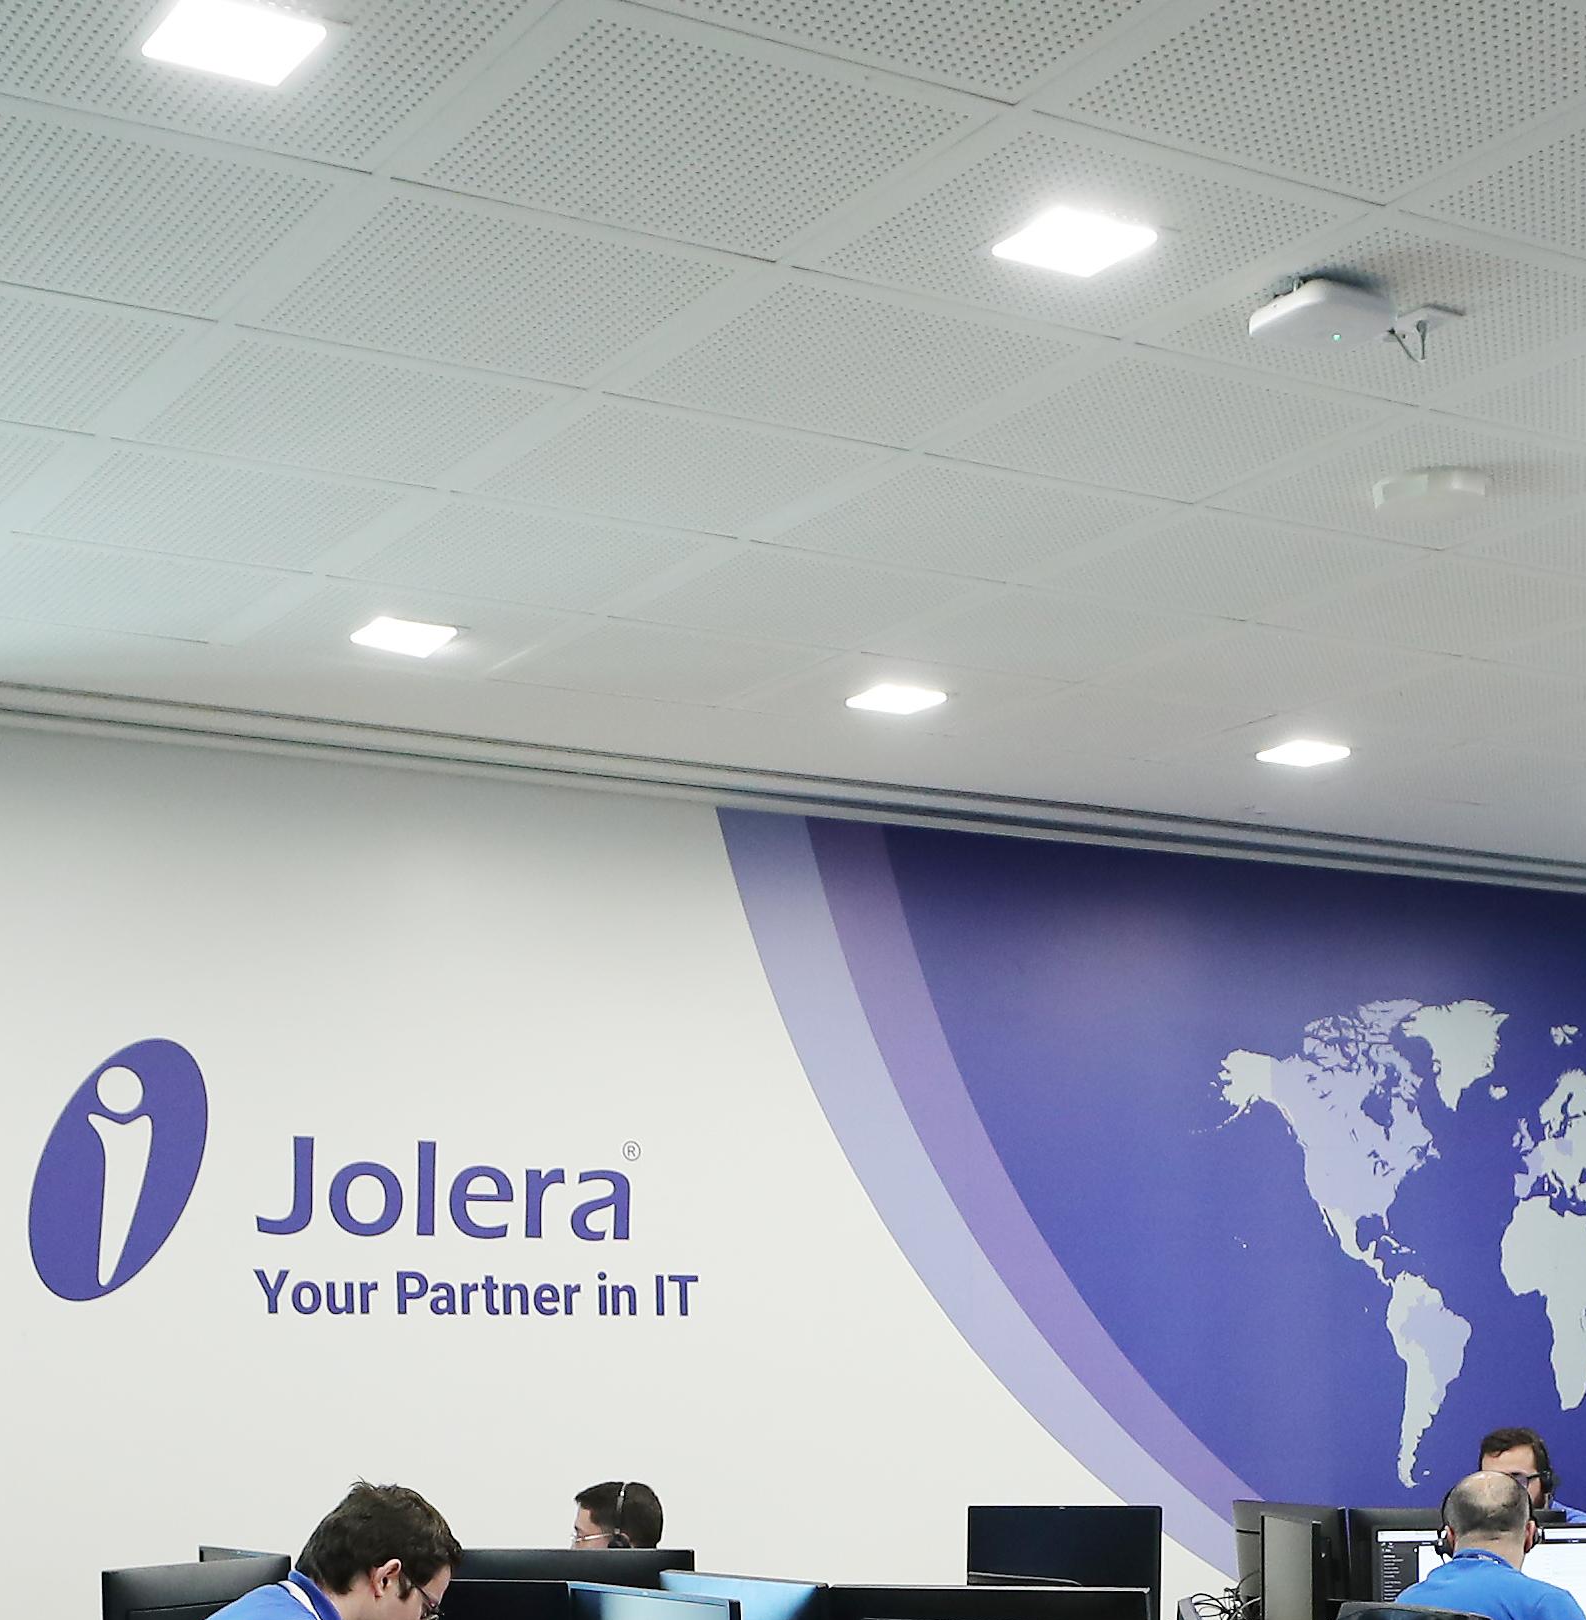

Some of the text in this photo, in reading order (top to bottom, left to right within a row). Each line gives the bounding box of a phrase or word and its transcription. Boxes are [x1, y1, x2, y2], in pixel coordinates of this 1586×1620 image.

[253, 1269, 699, 1317] Your Partner in IT
